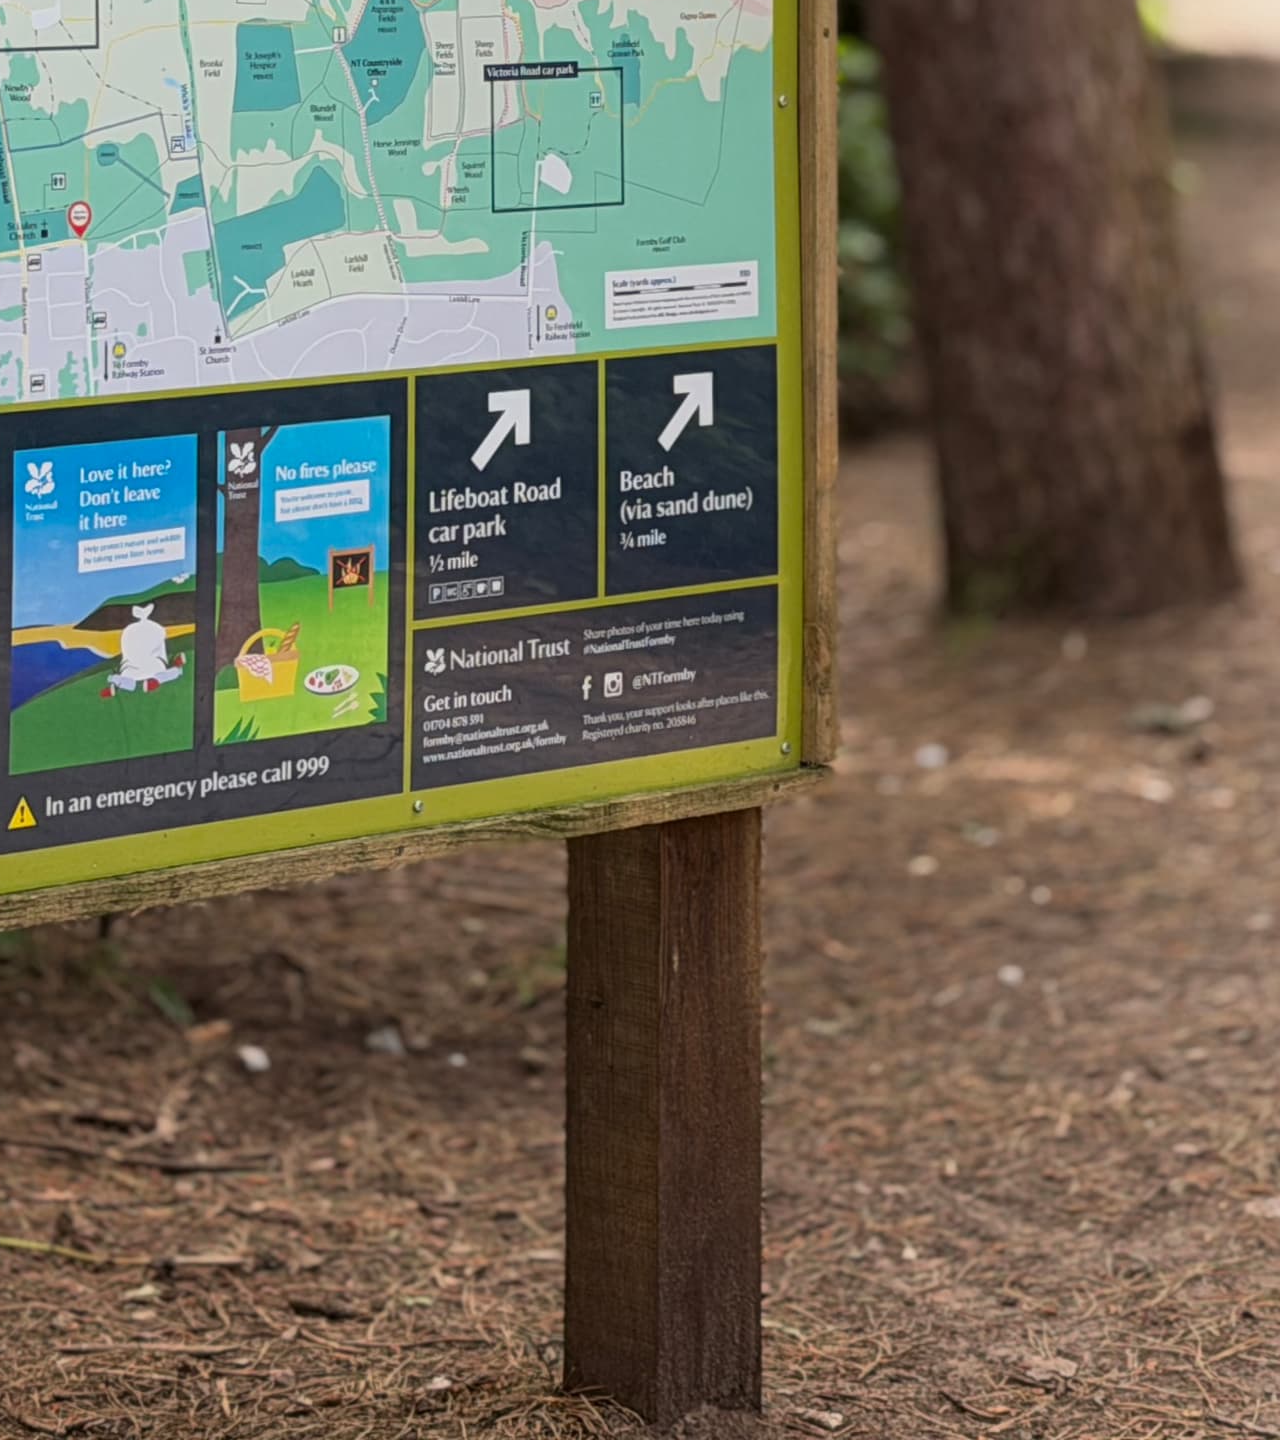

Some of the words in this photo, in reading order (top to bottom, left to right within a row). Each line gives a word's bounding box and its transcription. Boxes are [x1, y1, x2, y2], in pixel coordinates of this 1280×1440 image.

[487, 66, 519, 77] Victoria
[520, 65, 541, 76] Road
[542, 66, 555, 75] car
[556, 64, 575, 77] park
[80, 467, 114, 484] Love
[117, 463, 128, 480] it
[132, 459, 172, 478] here?
[275, 465, 297, 482] No
[299, 462, 330, 479] fires
[332, 459, 377, 479] please
[620, 466, 675, 492] Beach
[79, 488, 121, 507] Don't
[123, 486, 161, 503] leave
[429, 487, 509, 513] Lifeboat
[513, 477, 561, 503] Road
[620, 498, 652, 525] (via
[656, 492, 699, 517] sand
[702, 487, 753, 512] dune)
[79, 514, 90, 531] it
[93, 512, 128, 529] here
[428, 525, 460, 544] car
[463, 514, 507, 545] park
[637, 528, 667, 547] mile
[447, 551, 479, 570] mile
[450, 642, 523, 670] National
[527, 639, 570, 659] Trust
[632, 667, 697, 690] @NTFormby
[423, 695, 451, 713] Get
[453, 691, 468, 709] in
[470, 684, 512, 706] touch
[46, 796, 64, 817] In
[68, 795, 92, 813] an
[96, 781, 197, 808] emergency
[200, 771, 258, 798] please
[261, 760, 292, 784] call
[295, 755, 330, 779] 999
